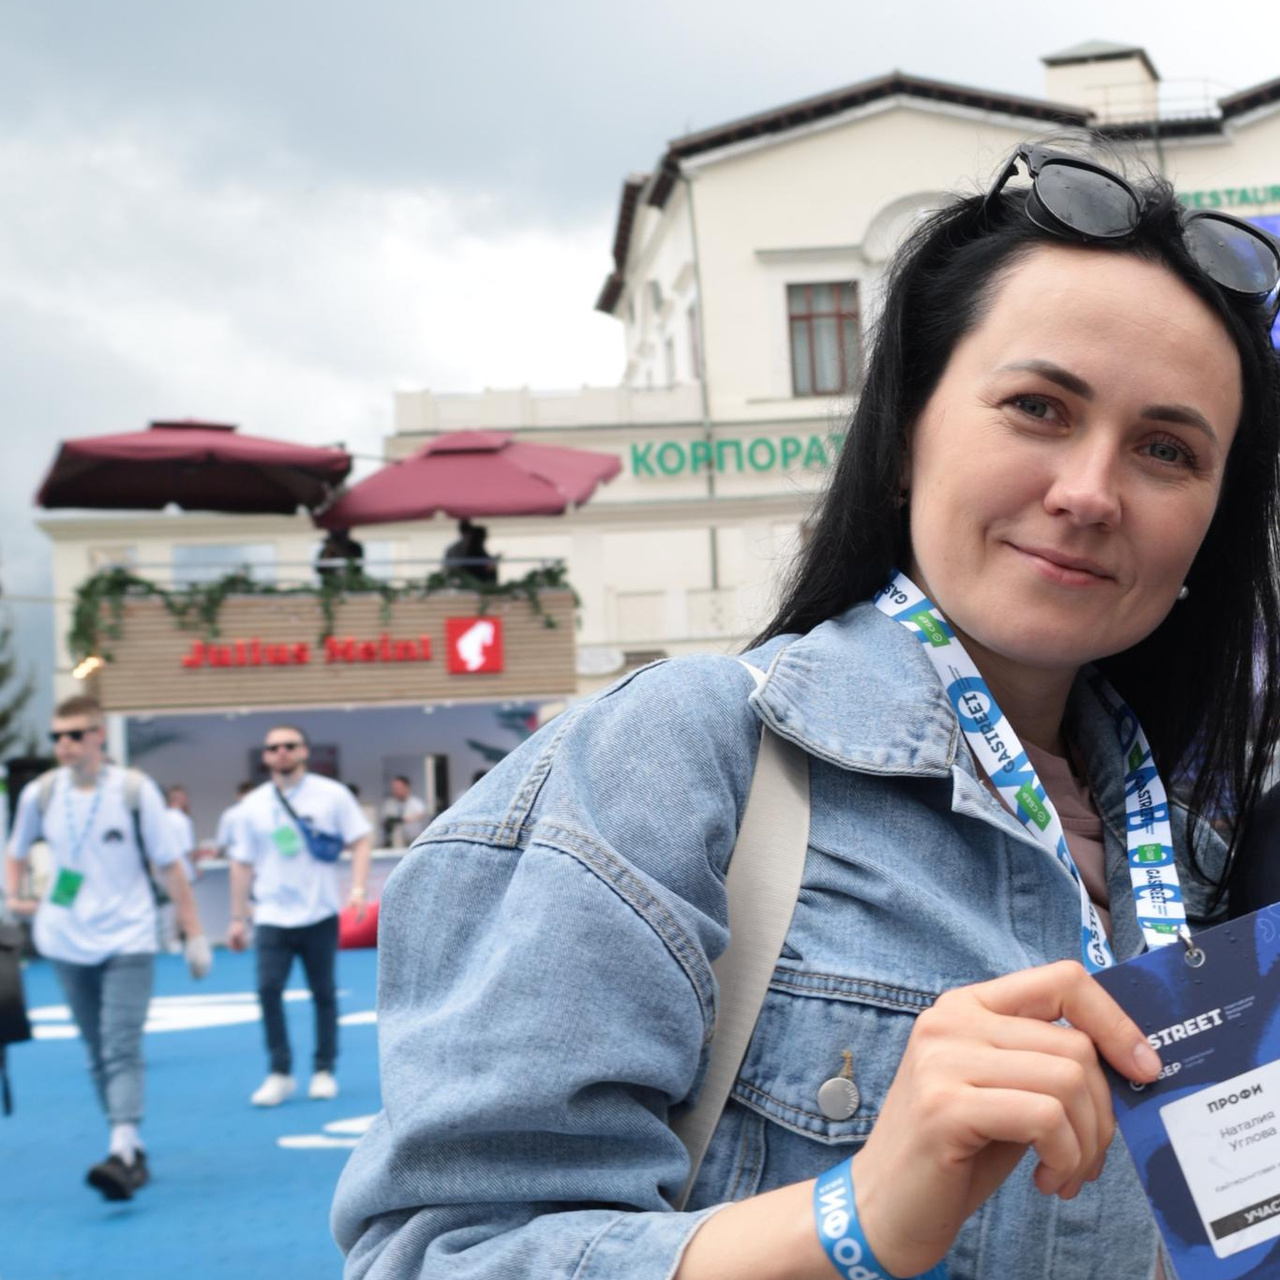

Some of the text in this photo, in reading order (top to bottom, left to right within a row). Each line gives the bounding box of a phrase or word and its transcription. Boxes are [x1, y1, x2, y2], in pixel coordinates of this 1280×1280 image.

[961, 692, 1016, 774] GASTREET
[1207, 1082, 1264, 1113] ПРОФИ
[1219, 1111, 1276, 1139] Наталия
[1228, 1126, 1278, 1152] Углова
